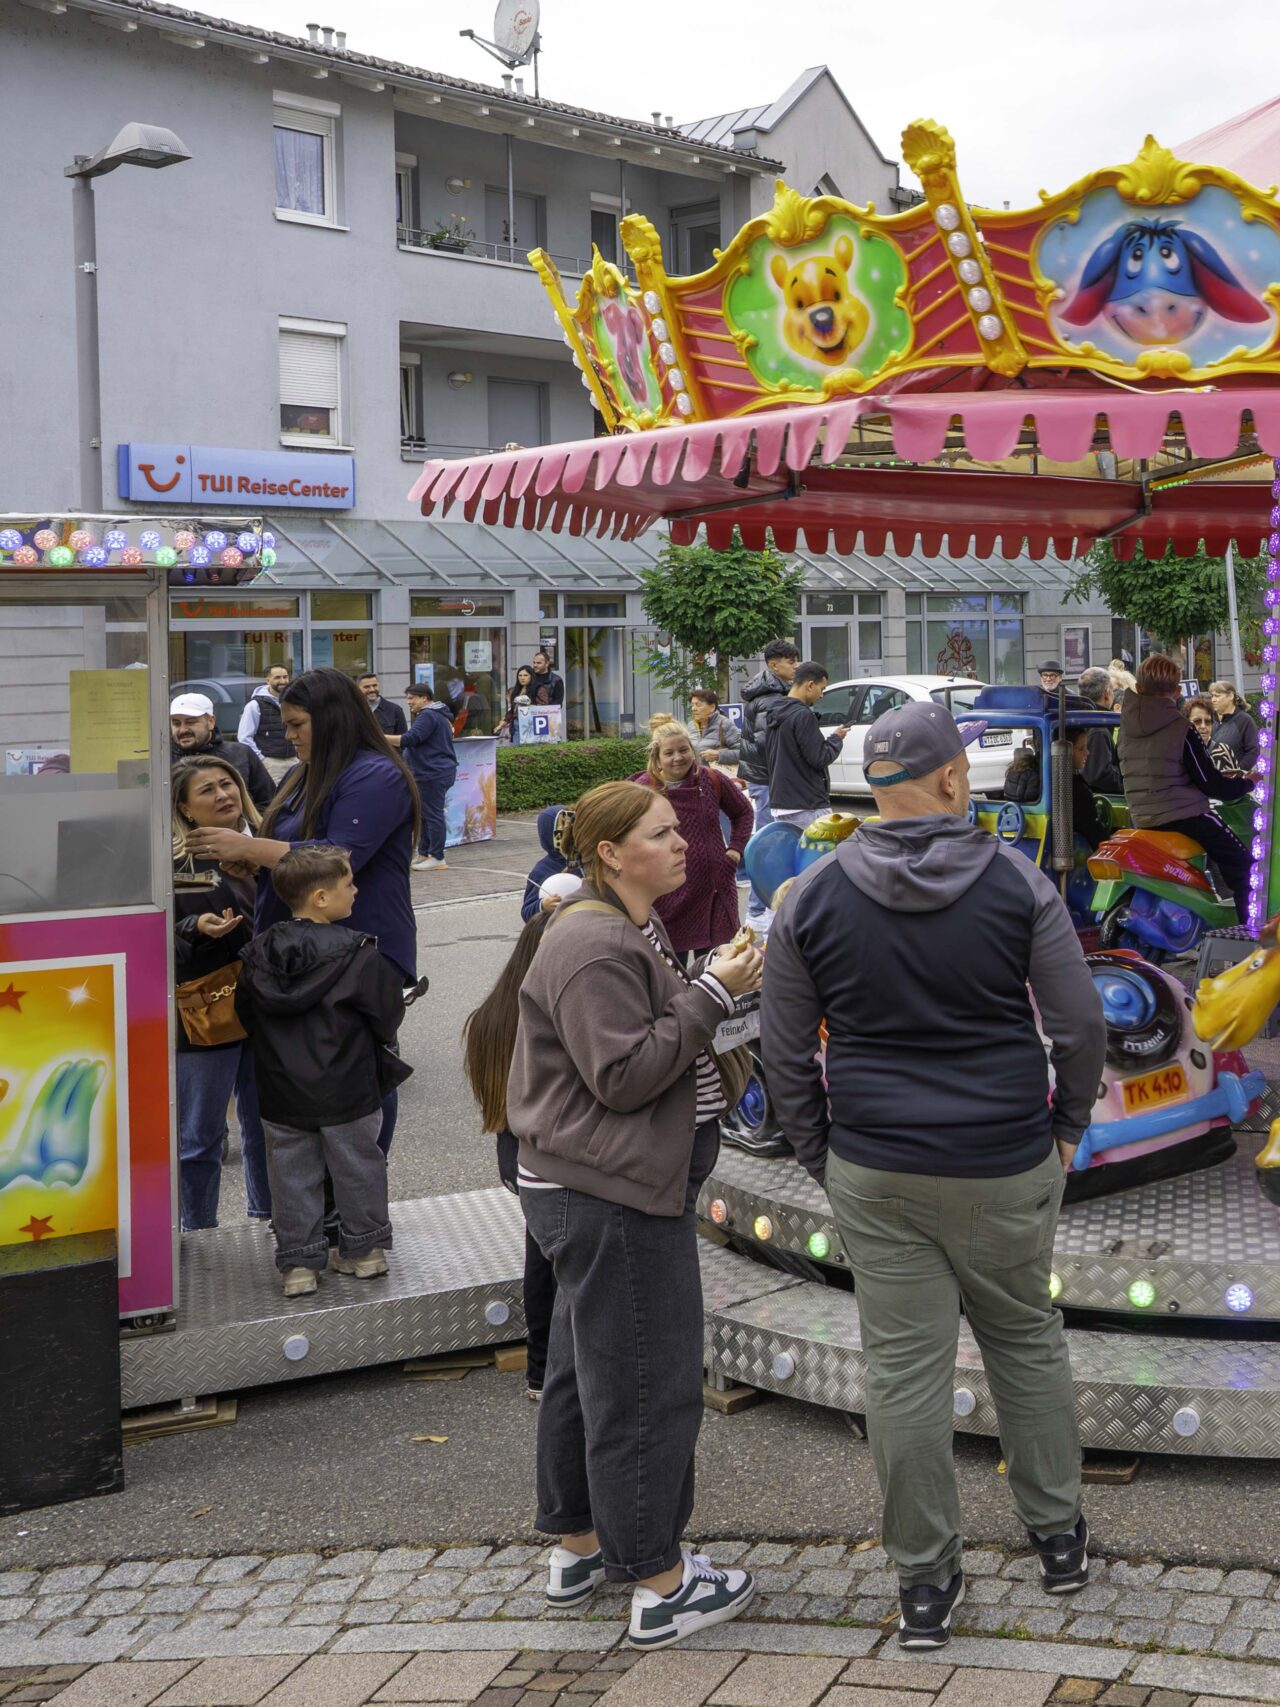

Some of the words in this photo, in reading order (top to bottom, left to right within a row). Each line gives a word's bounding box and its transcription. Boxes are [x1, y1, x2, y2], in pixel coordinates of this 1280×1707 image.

[198, 473, 232, 493] TUI
[237, 475, 348, 498] ReiseCenter
[826, 603, 834, 612] 73
[728, 707, 741, 721] P
[535, 717, 548, 735] P
[1163, 863, 1192, 883] SUZUKI
[1123, 1028, 1165, 1050] PIRELLI
[1124, 1080, 1150, 1105] TK
[1152, 1071, 1182, 1097] 4.10
